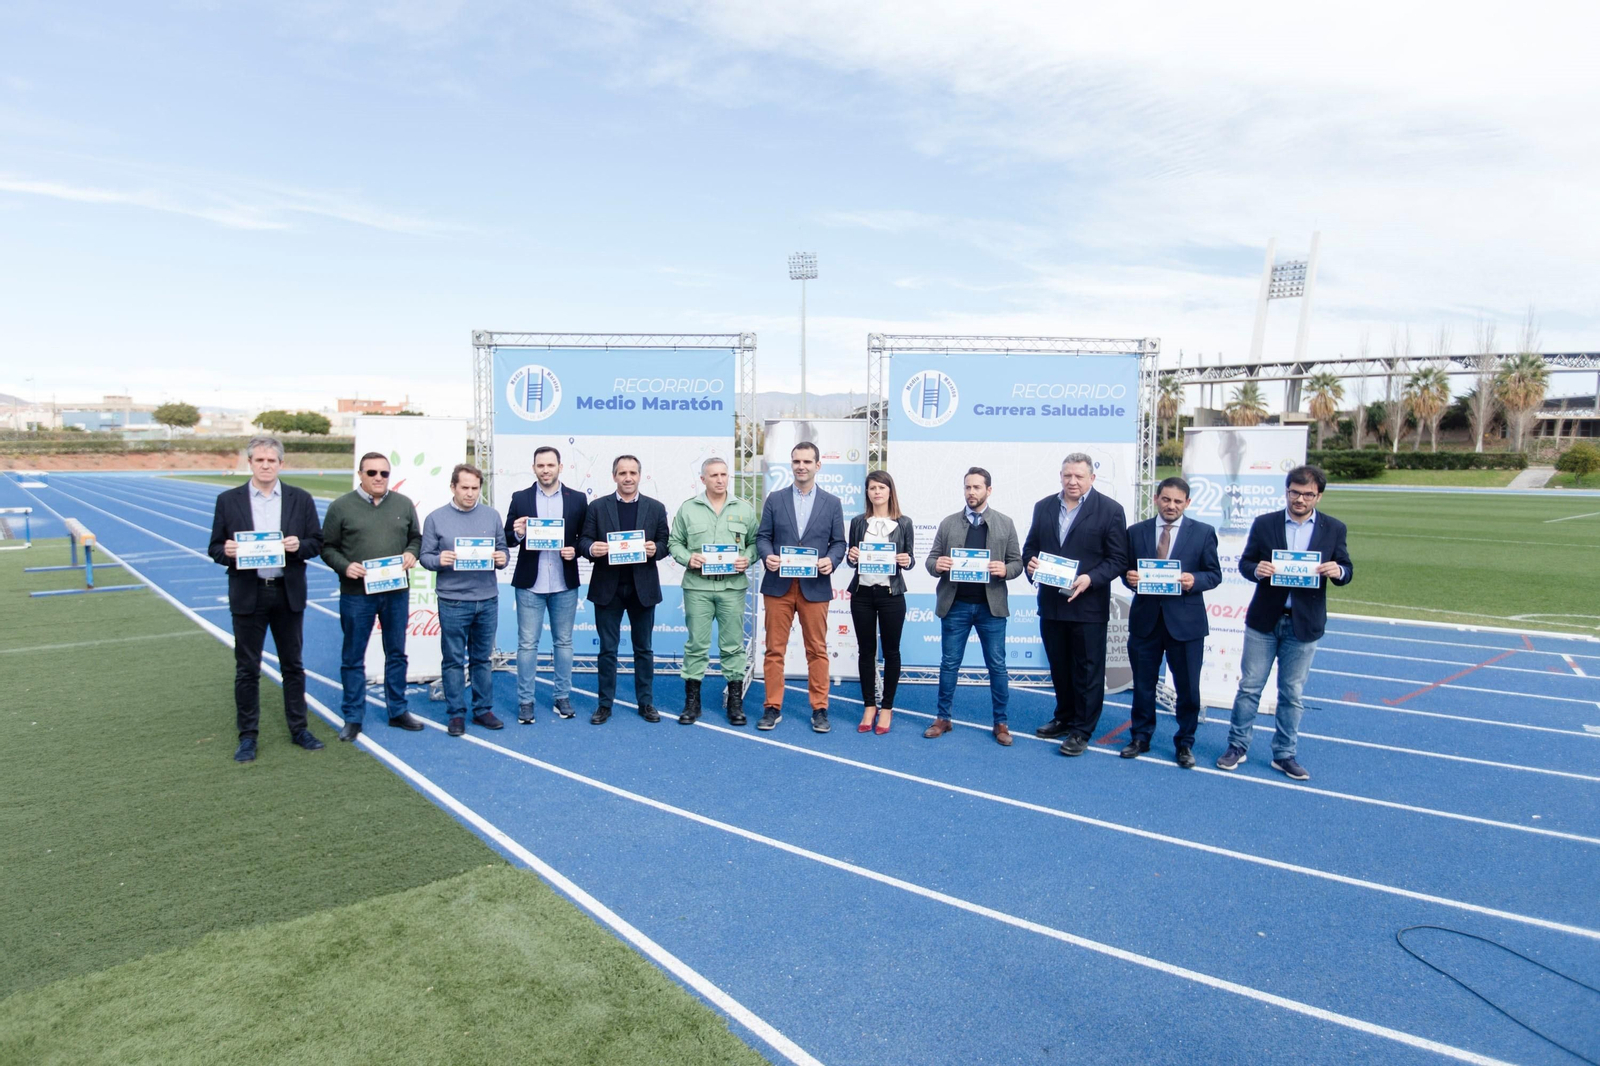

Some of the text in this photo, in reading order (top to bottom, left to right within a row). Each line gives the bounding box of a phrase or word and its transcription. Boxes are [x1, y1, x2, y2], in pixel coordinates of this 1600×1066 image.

[613, 378, 724, 393] RECORRIDO
[1011, 383, 1127, 399] RECORRIDO
[576, 395, 723, 411] Medio Maratón
[973, 404, 1125, 417] Carrera Saludable
[1232, 485, 1275, 495] MEDIO
[1231, 495, 1287, 507] MARATÓ
[1284, 565, 1308, 573] NEXA
